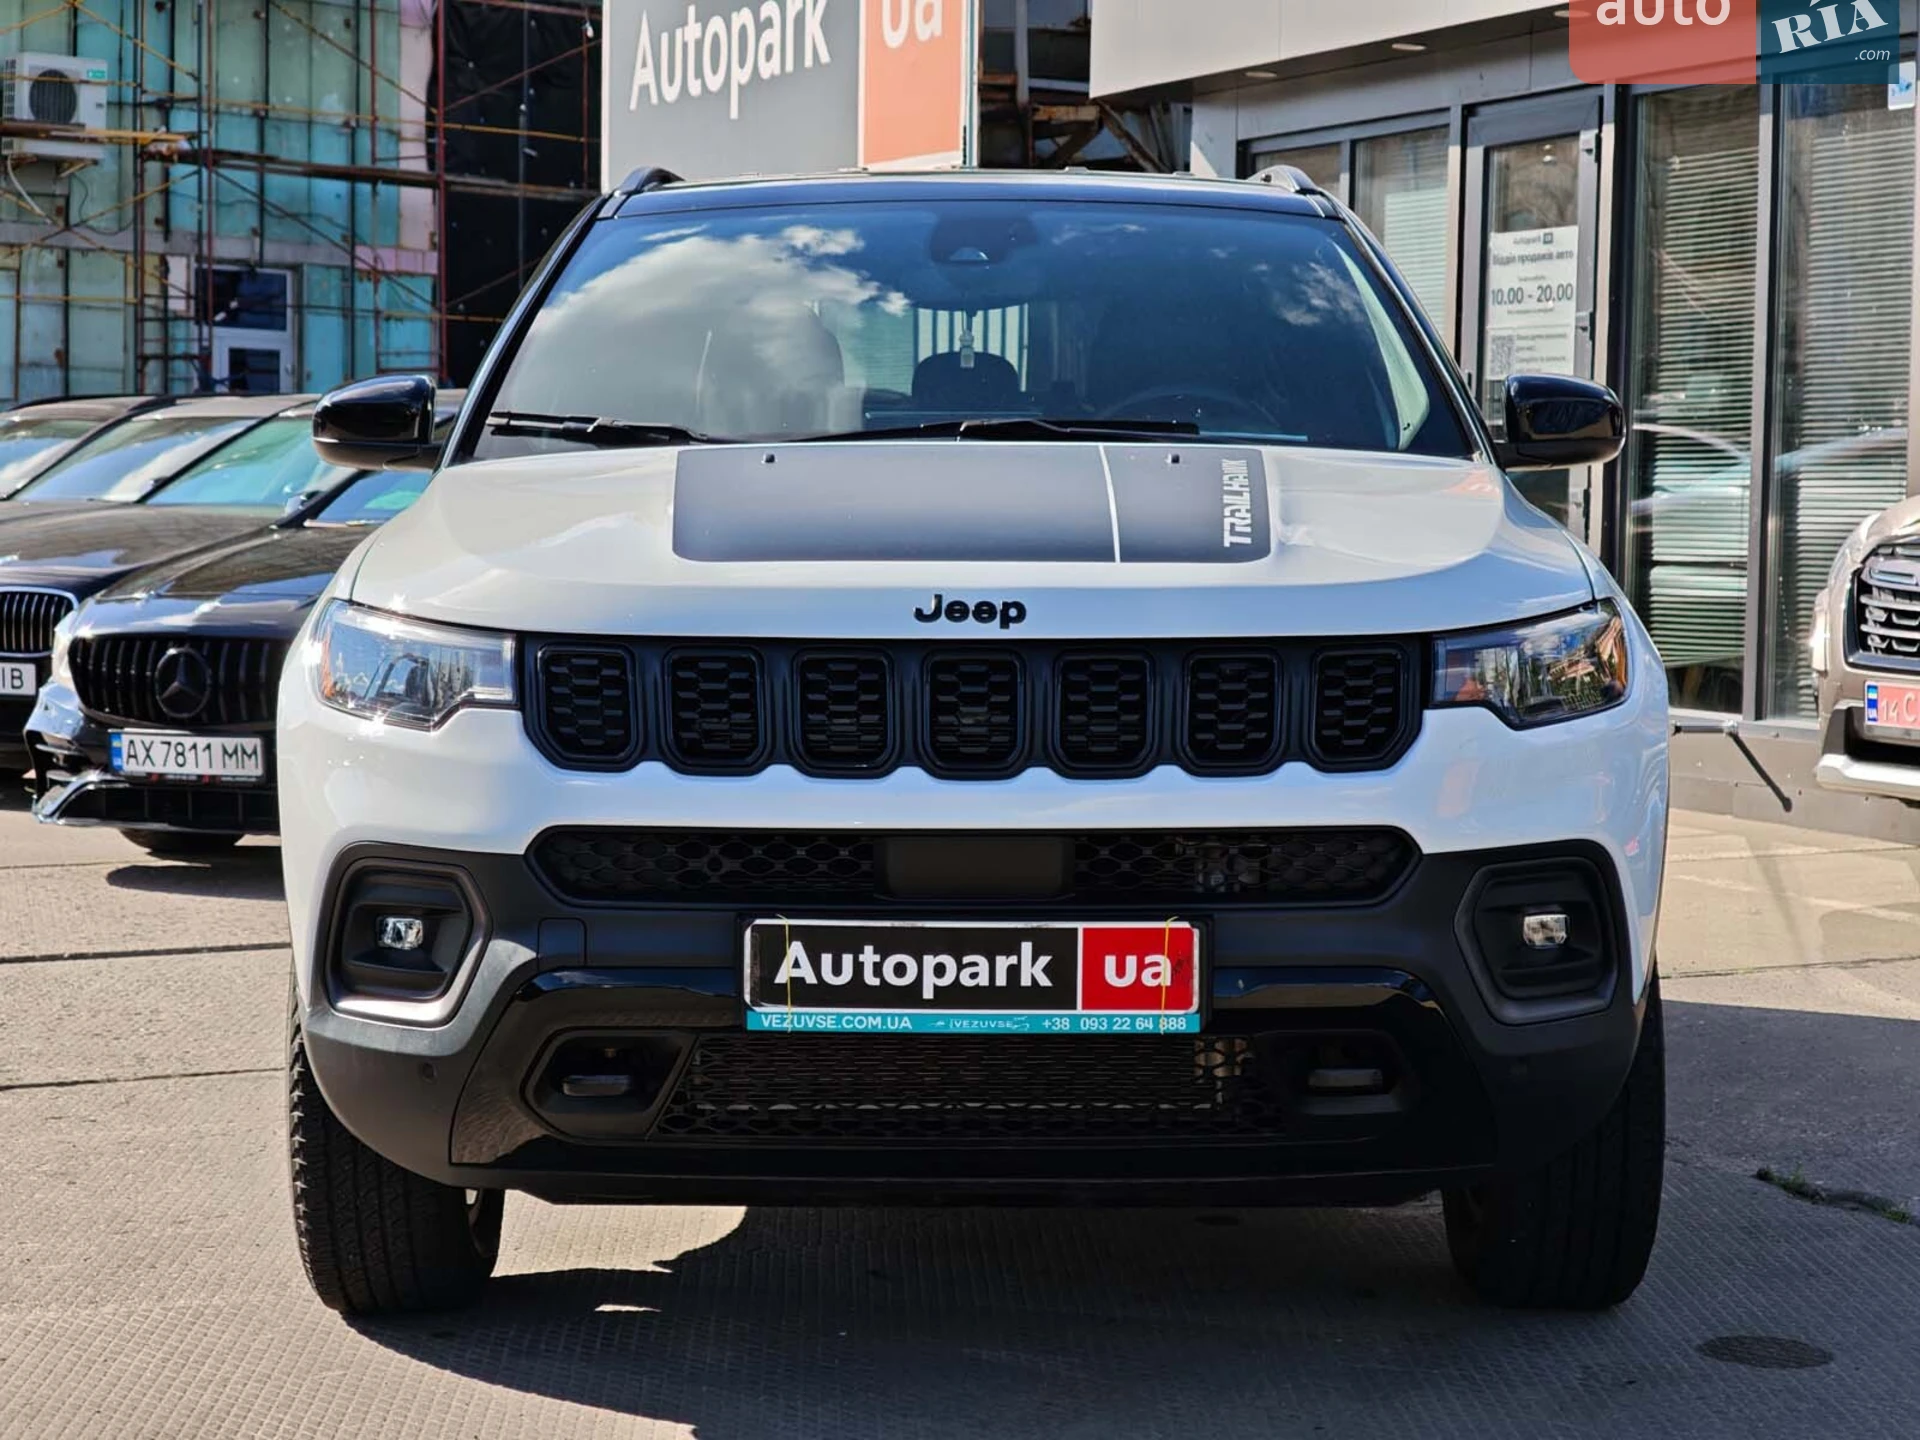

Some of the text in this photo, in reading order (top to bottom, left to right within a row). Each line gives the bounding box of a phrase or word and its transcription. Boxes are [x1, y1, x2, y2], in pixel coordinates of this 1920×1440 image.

[629, 0, 831, 120] Autopark
[1491, 286, 1523, 306] 10.00
[1537, 283, 1573, 303] 20.00
[1222, 459, 1252, 547] TRAILHAWK
[913, 594, 1027, 629] Jeep
[222, 743, 259, 769] MM
[774, 941, 1172, 999] Autopark ua
[761, 1013, 913, 1030] VEZUVSE.COM.UA
[1042, 1017, 1070, 1030] +38
[1080, 1017, 1107, 1030] 093
[1112, 1017, 1131, 1030] 22
[1135, 1017, 1153, 1030] 64
